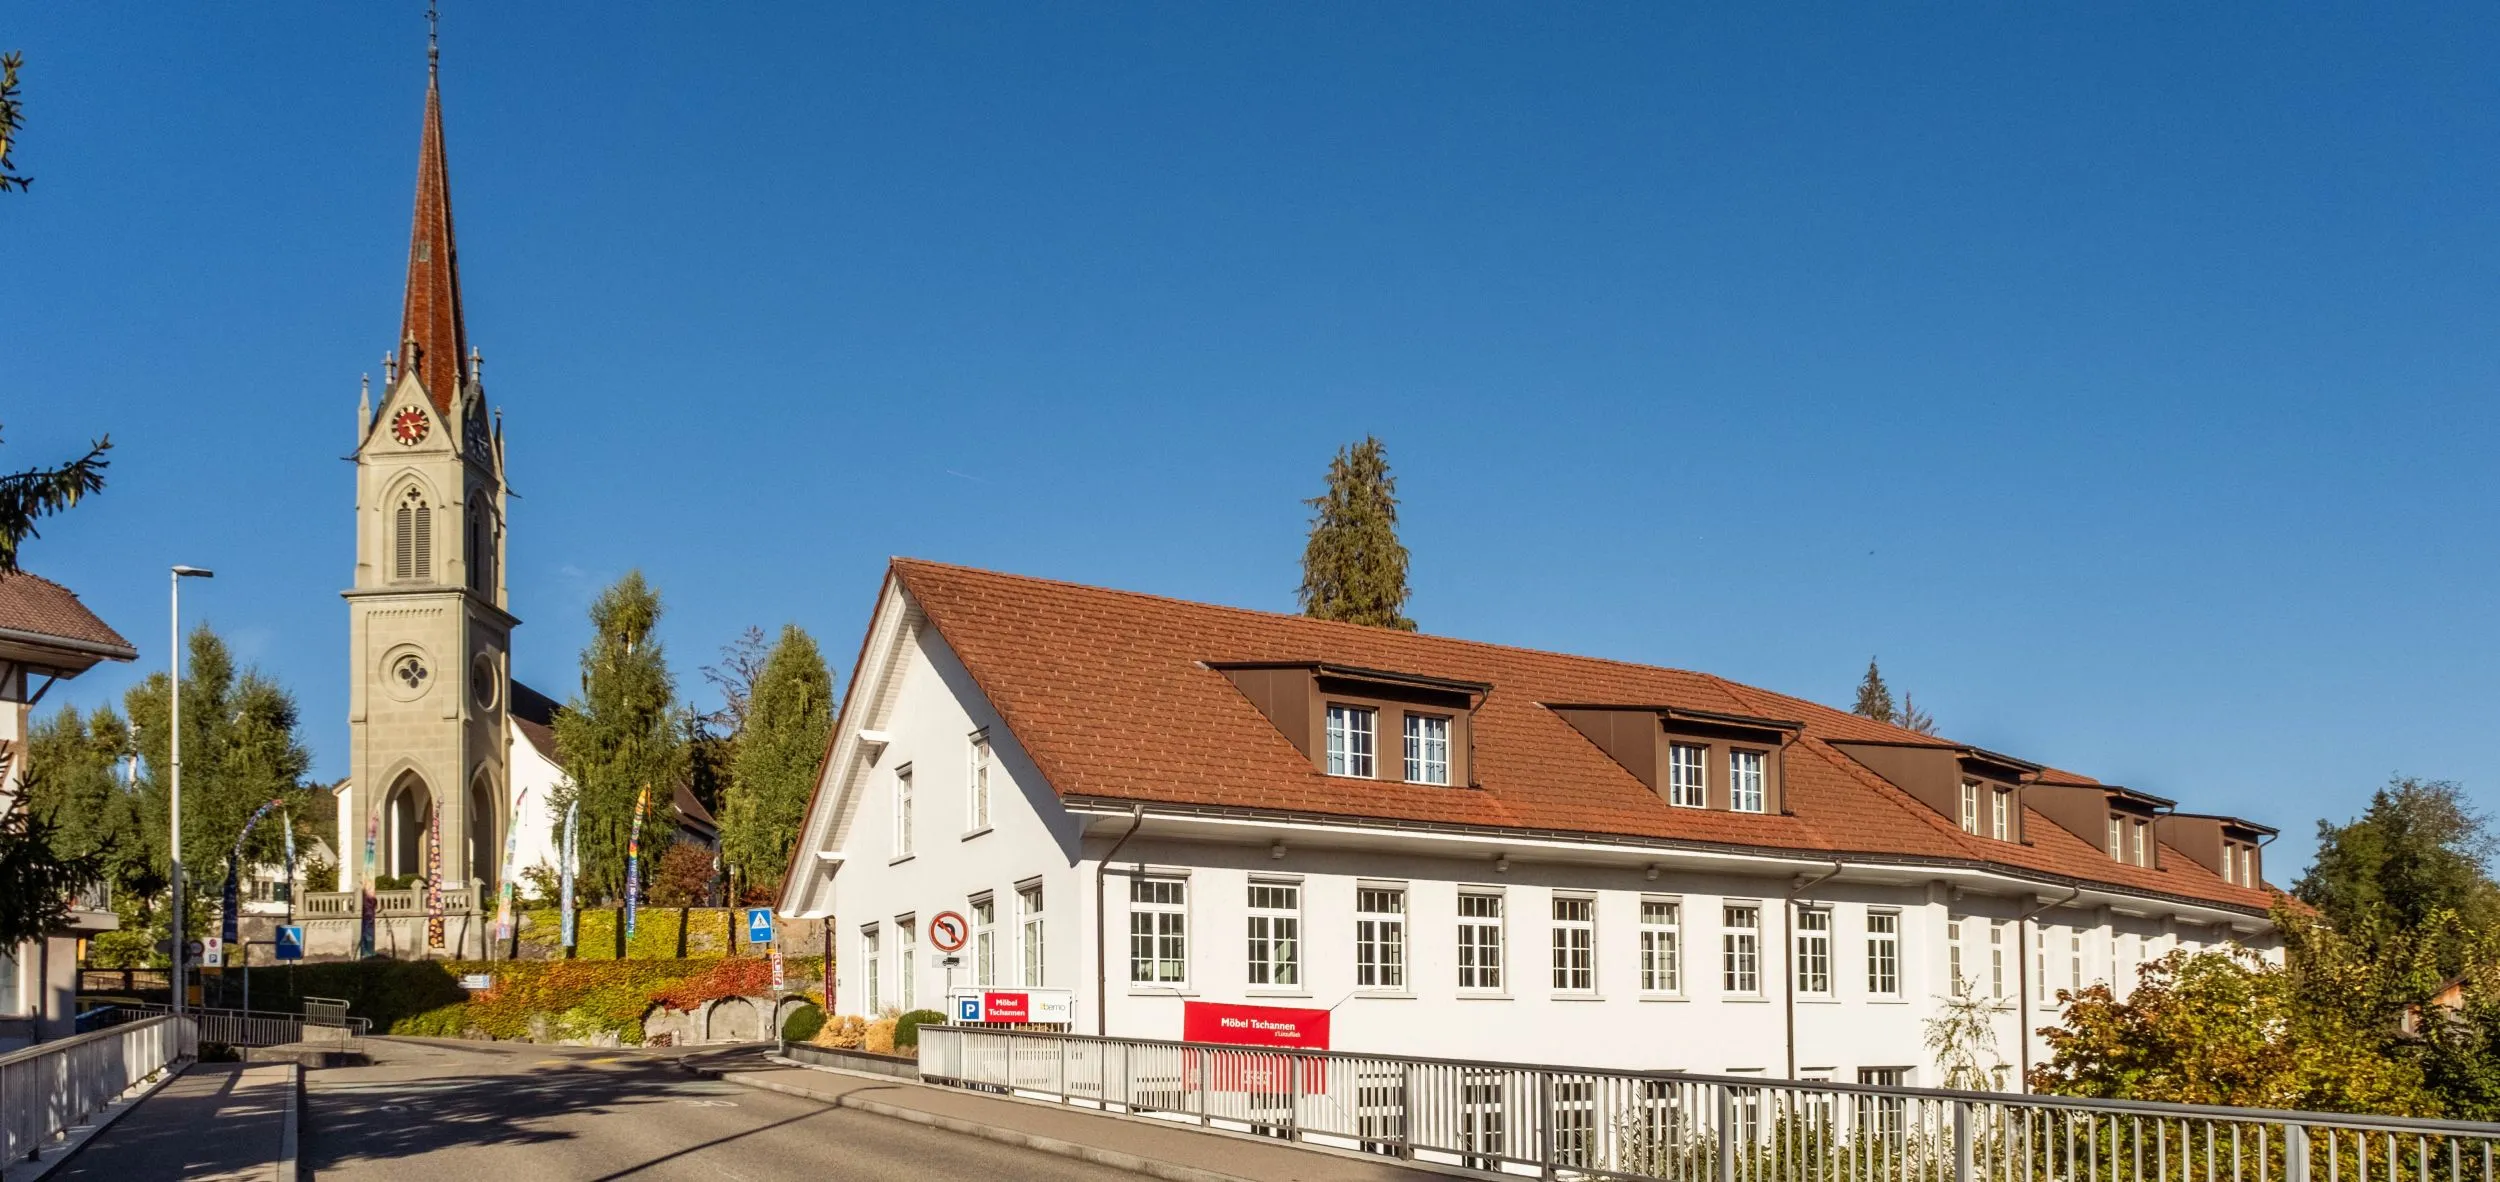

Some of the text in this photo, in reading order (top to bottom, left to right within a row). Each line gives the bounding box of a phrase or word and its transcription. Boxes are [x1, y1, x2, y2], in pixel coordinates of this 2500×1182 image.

[996, 998, 1018, 1007] Möbel
[965, 1004, 976, 1017] P
[988, 1008, 1026, 1017] Tschannen
[1221, 1017, 1296, 1031] Möbel Tschannen
